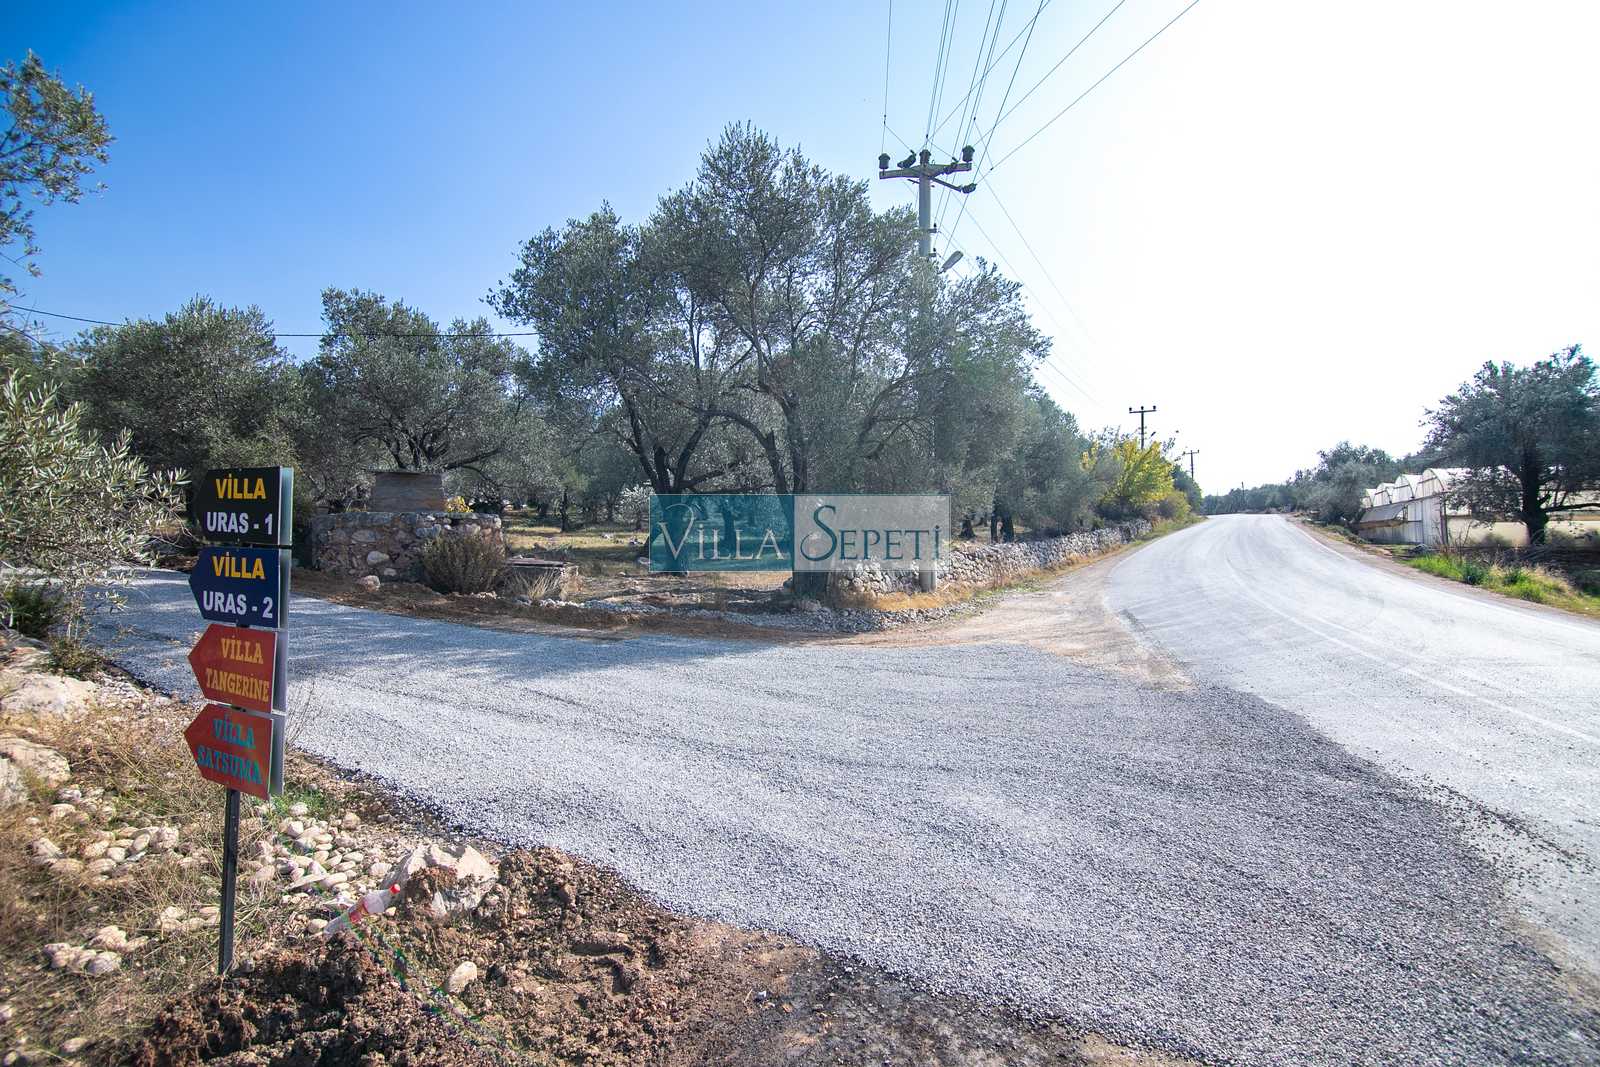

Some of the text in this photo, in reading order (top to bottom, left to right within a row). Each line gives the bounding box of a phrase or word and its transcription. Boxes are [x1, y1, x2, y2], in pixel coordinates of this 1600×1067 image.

[216, 474, 266, 499] VİLLA
[207, 512, 249, 534] URAS
[264, 514, 273, 535] 1
[212, 552, 266, 579] VİLLA
[203, 591, 247, 615] URAS
[262, 597, 273, 619] 2
[221, 635, 264, 665] VİLLA
[205, 667, 270, 702] TANGERİNE
[197, 745, 262, 785] SATSUMA
